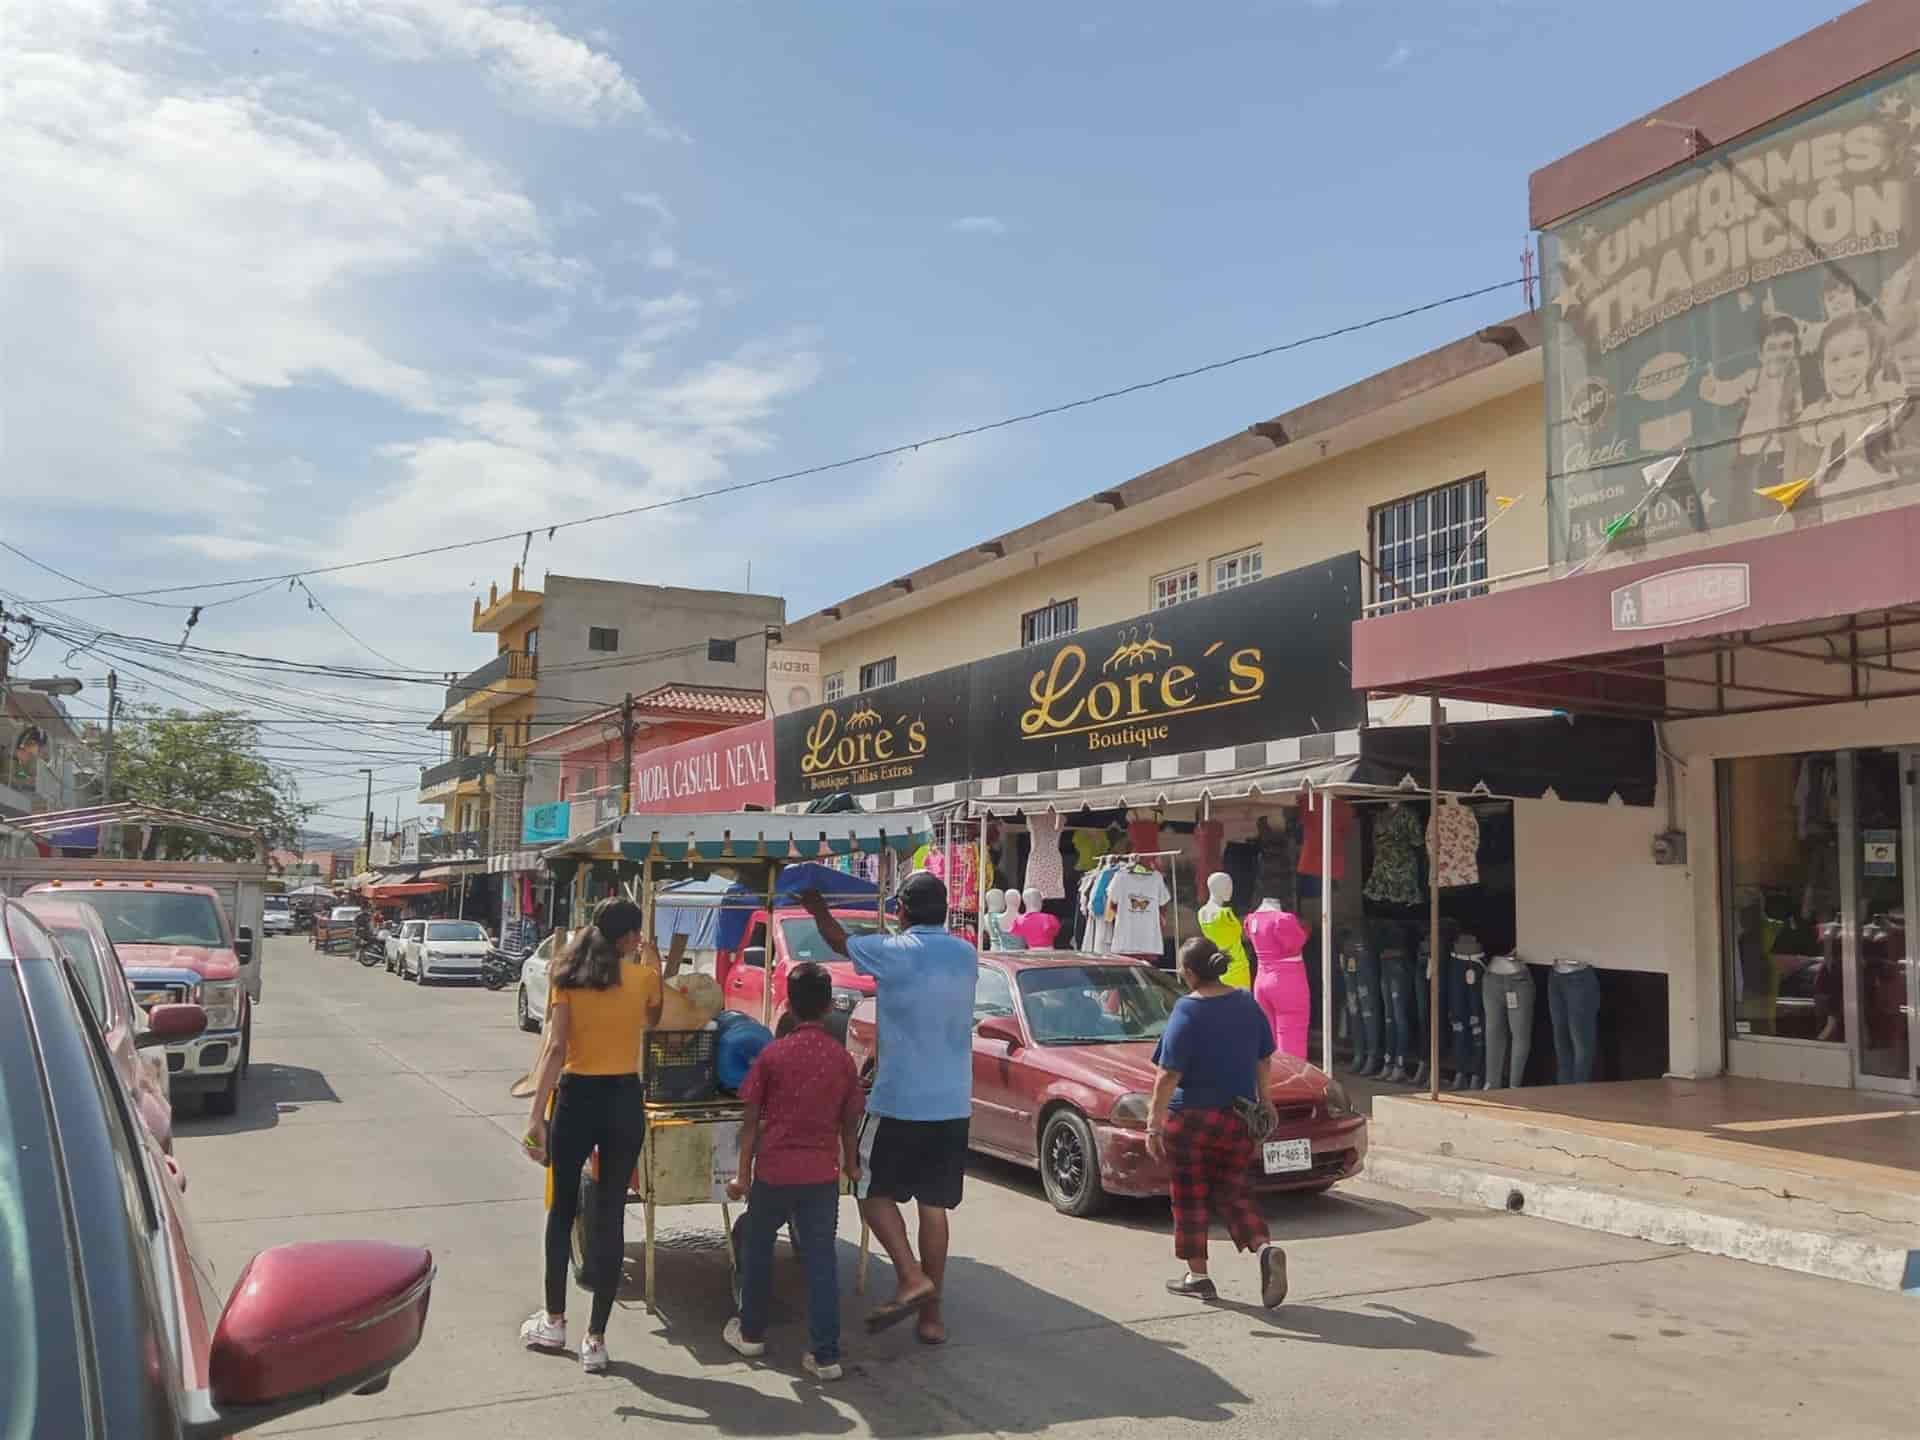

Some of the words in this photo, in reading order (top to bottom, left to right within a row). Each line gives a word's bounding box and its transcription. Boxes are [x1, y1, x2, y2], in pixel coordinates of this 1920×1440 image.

[1586, 177, 1902, 345] TRADICIÓN
[1088, 723, 1169, 751] Boutique
[639, 766, 670, 803] MODA
[673, 752, 721, 797] CASUAL
[726, 740, 769, 788] NENA
[881, 765, 912, 780] Extras
